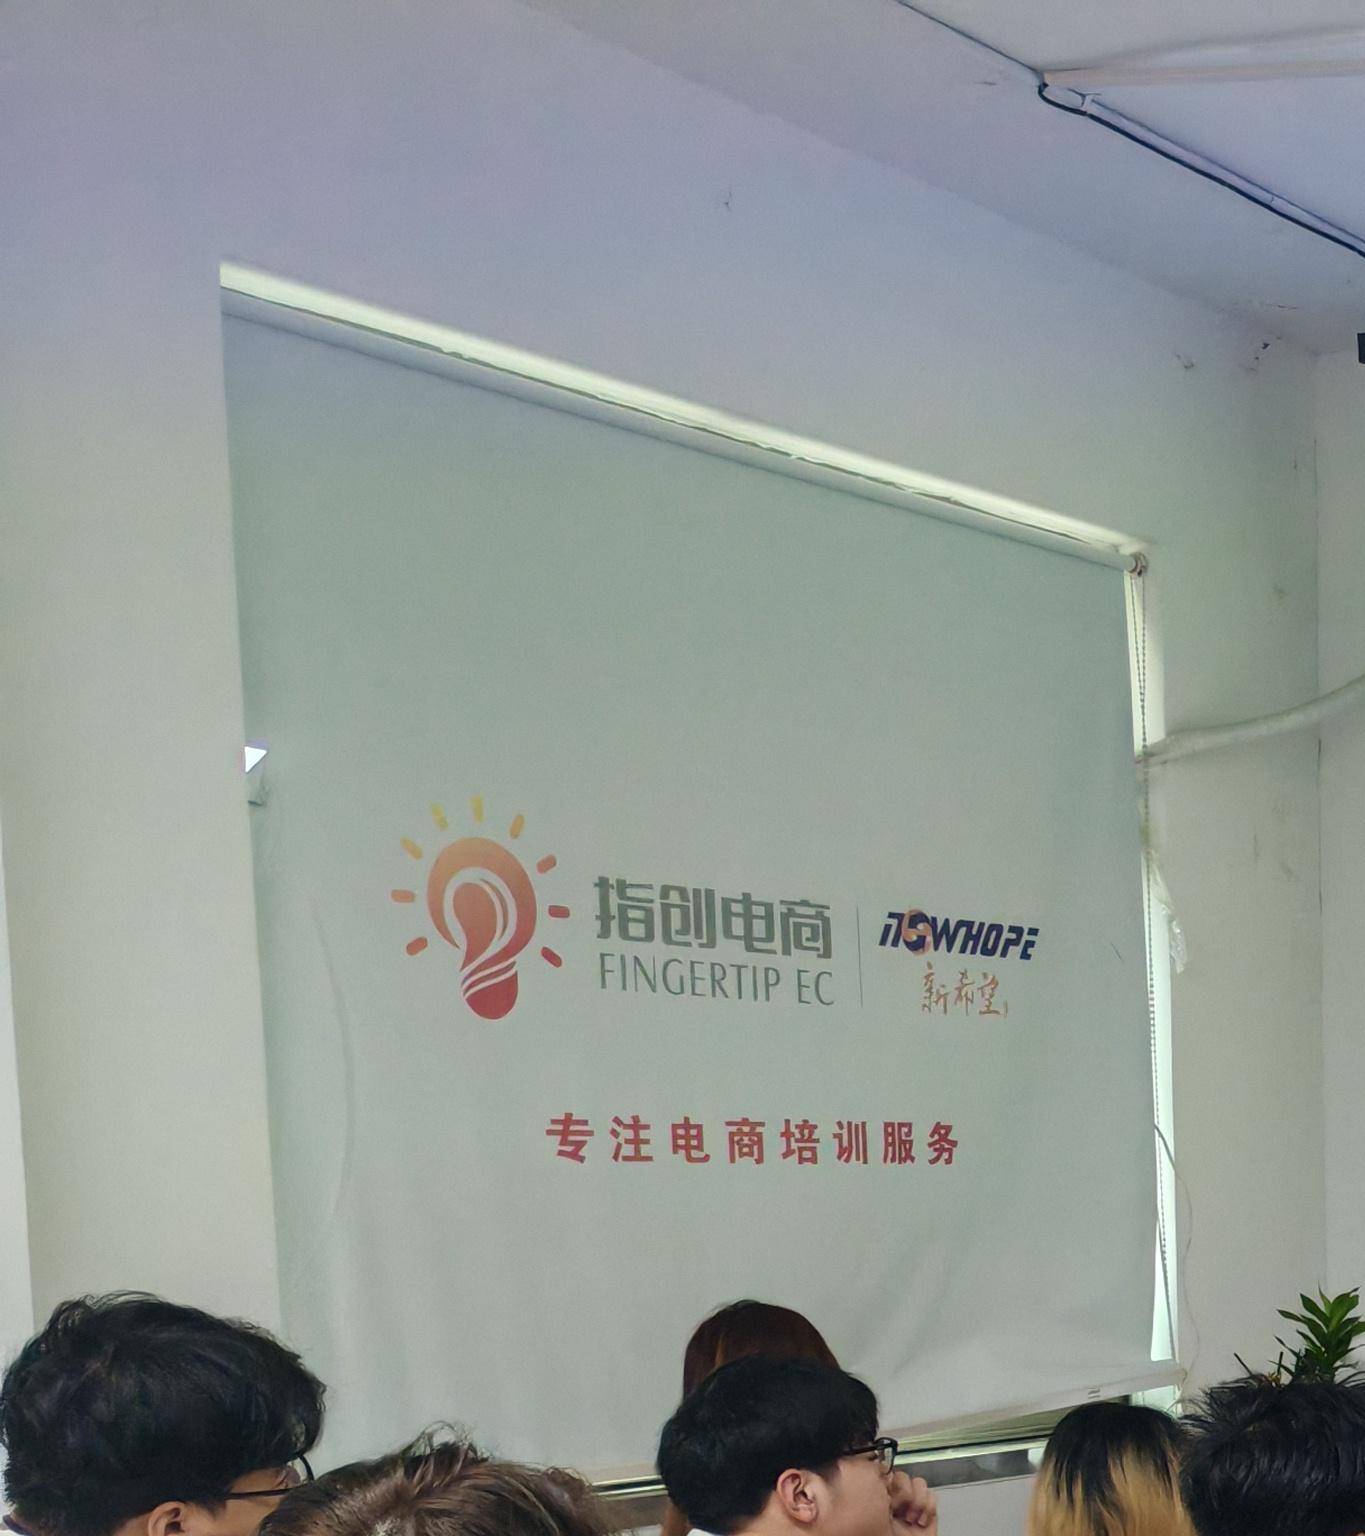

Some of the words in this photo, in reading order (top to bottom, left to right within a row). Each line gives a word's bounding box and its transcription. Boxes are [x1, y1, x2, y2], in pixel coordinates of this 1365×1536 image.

[593, 875, 833, 960] 指创电商
[599, 953, 781, 1003] FINGERTIP
[796, 968, 835, 1007] EC
[545, 1111, 960, 1166] 专注电商培训服务
